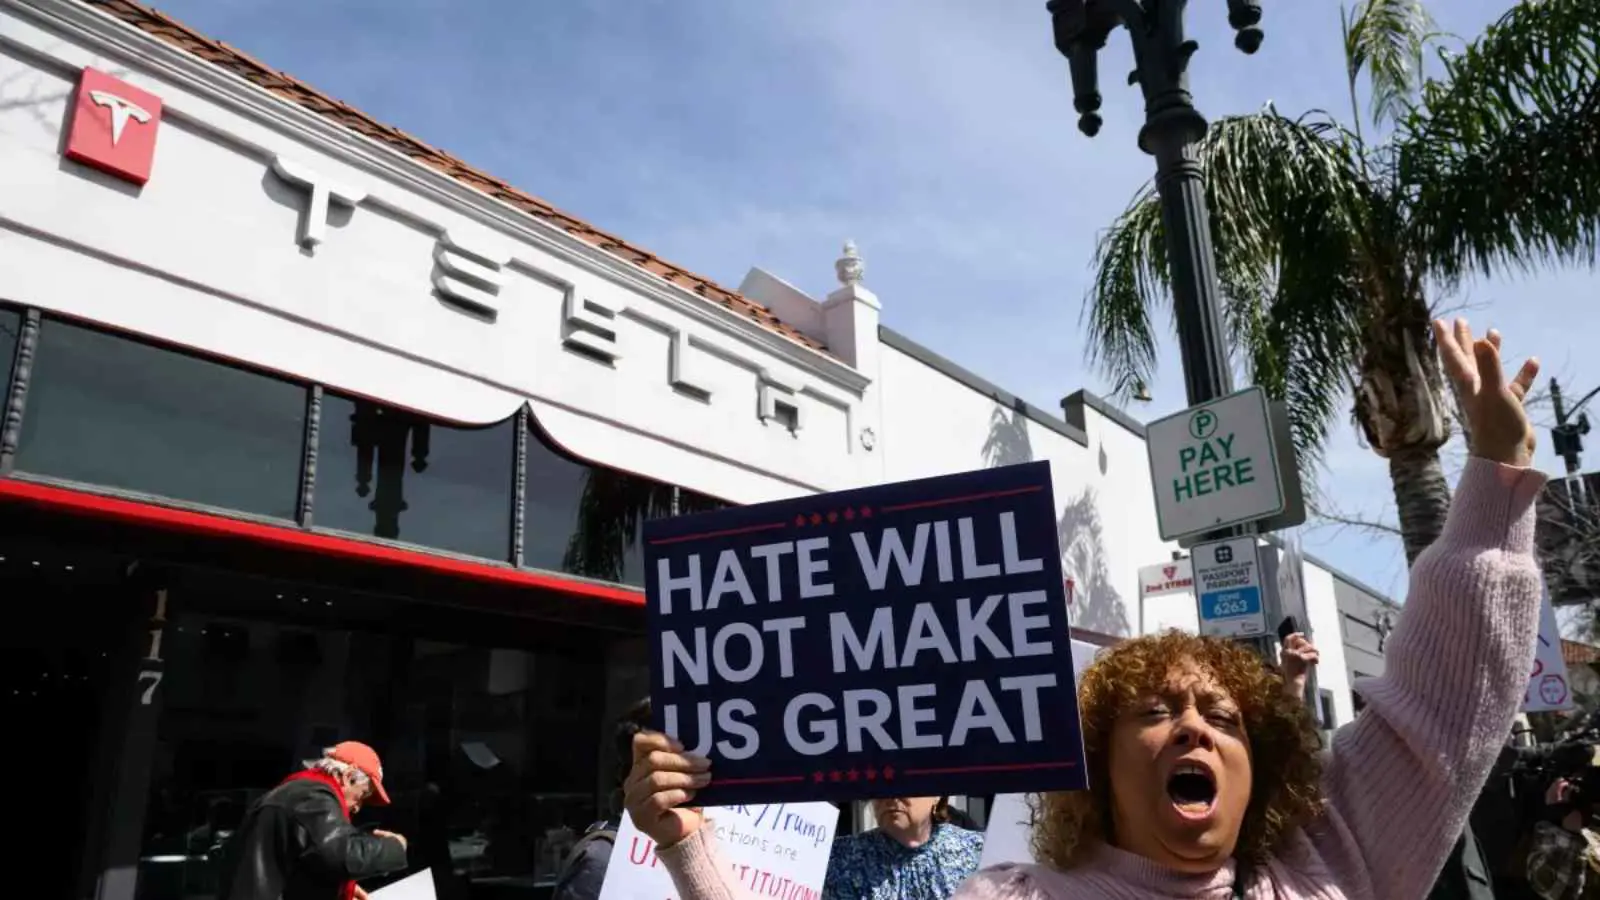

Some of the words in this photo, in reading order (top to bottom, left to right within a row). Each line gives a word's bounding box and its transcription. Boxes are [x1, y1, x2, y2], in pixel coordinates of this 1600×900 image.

[272, 154, 806, 436] TESLA
[1173, 457, 1255, 503] HERE
[1179, 433, 1235, 473] PAY
[657, 536, 835, 615] HATE
[850, 511, 1044, 591] WILL
[661, 616, 806, 688] NOT
[829, 590, 1054, 673] MAKE
[1213, 599, 1248, 616] 6263
[664, 698, 760, 760] US
[783, 673, 1057, 756] GREAT
[774, 844, 798, 861] are
